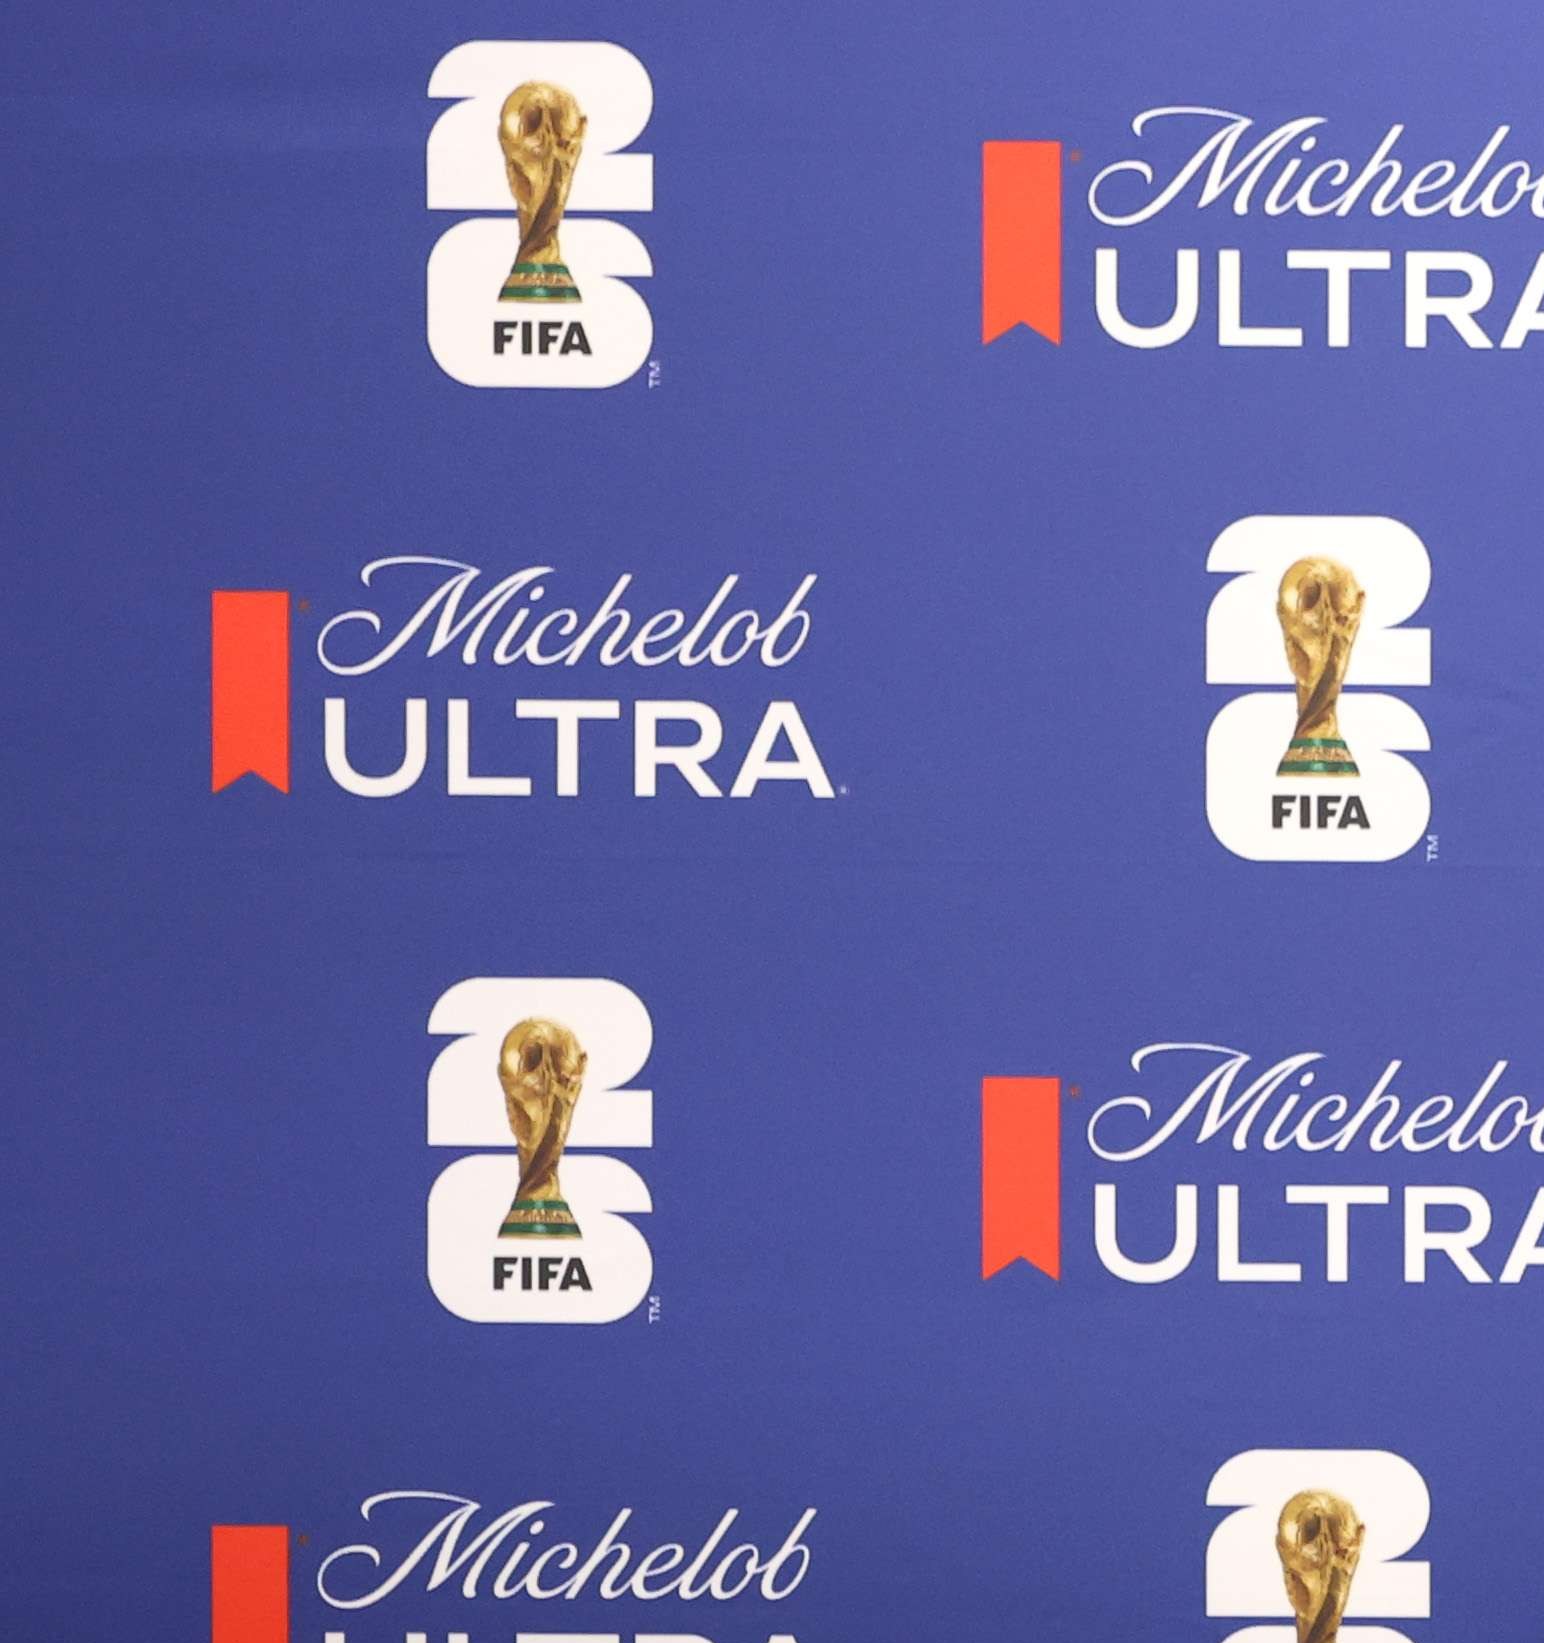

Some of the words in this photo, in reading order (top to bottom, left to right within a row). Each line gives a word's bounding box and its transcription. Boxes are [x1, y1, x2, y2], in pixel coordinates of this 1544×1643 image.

[494, 322, 591, 354] FIFA
[318, 556, 817, 675] Michelob
[325, 698, 834, 798] ULTRA
[1273, 796, 1369, 828] FIFA
[494, 1257, 592, 1290] FIFA
[318, 1491, 816, 1608] Michelob
